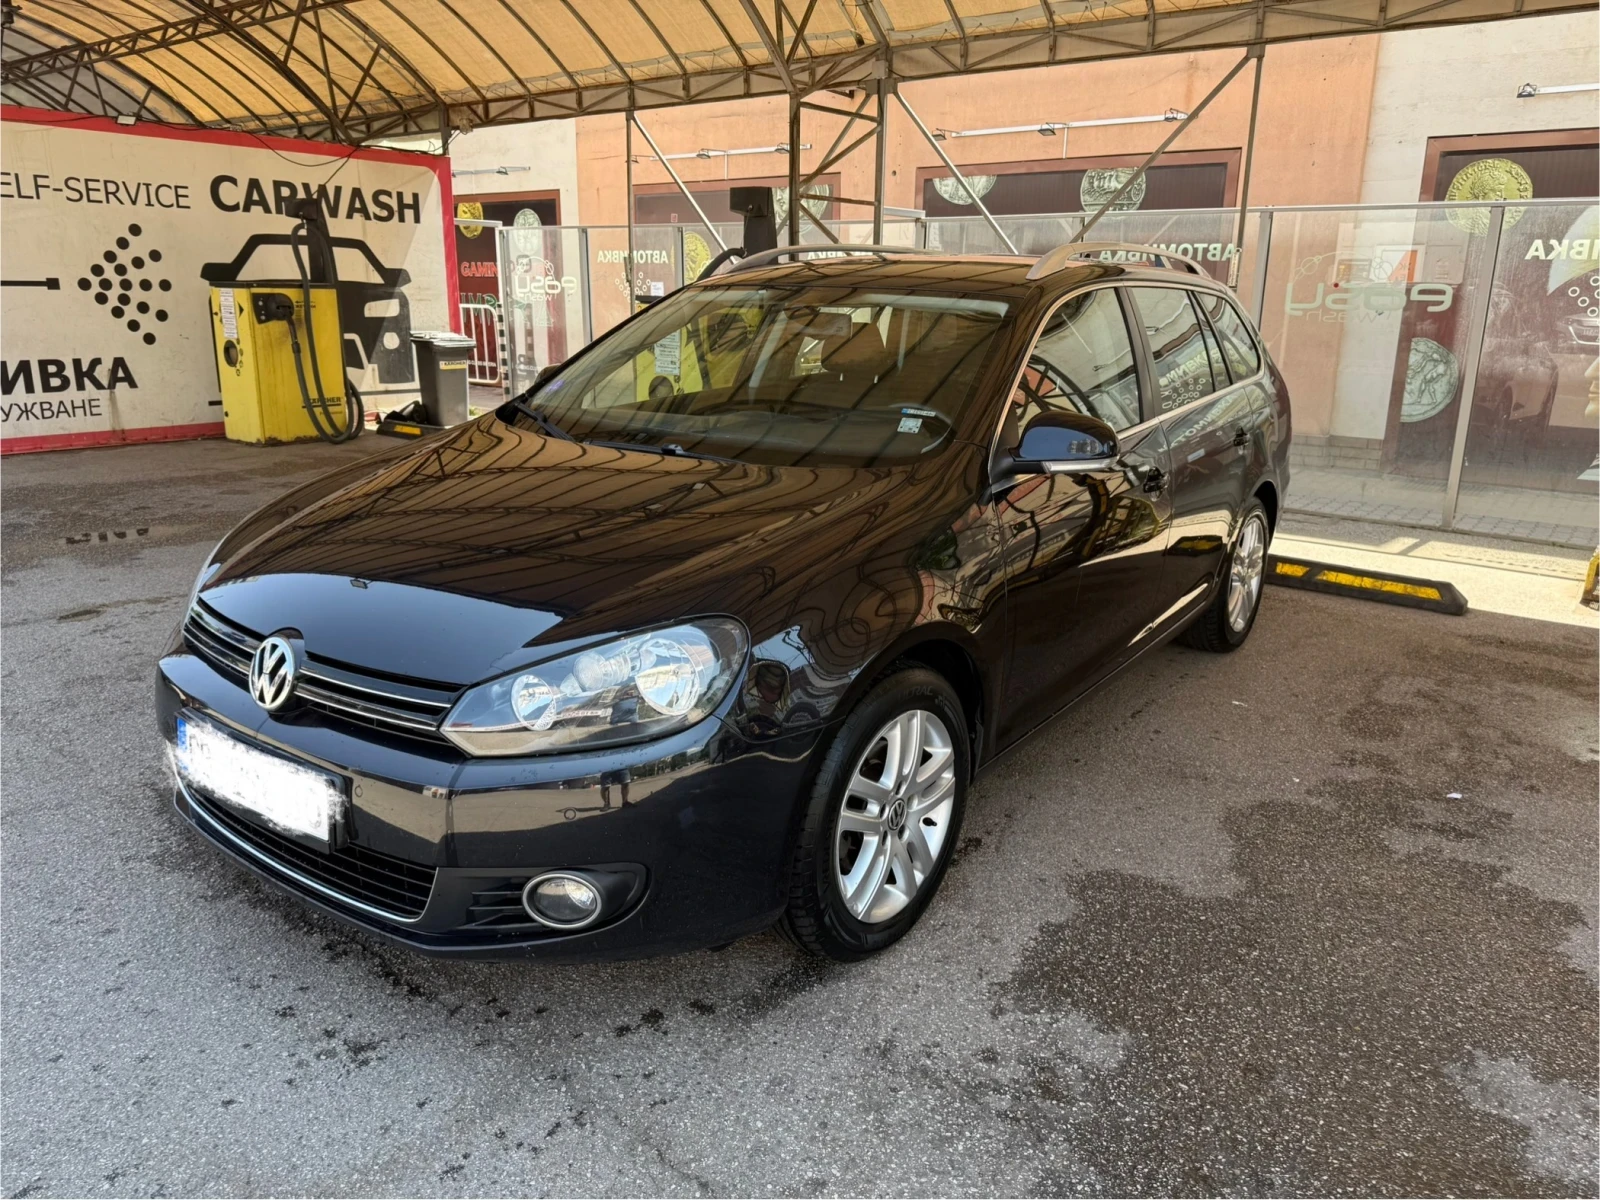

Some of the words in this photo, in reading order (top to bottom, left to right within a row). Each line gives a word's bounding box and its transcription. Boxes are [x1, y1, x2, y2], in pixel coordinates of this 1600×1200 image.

[0, 171, 192, 209] ELF-SERVICE
[209, 174, 421, 224] CARWASH
[0, 356, 139, 395] ИВКА
[0, 398, 103, 423] УЖВАНЕ
